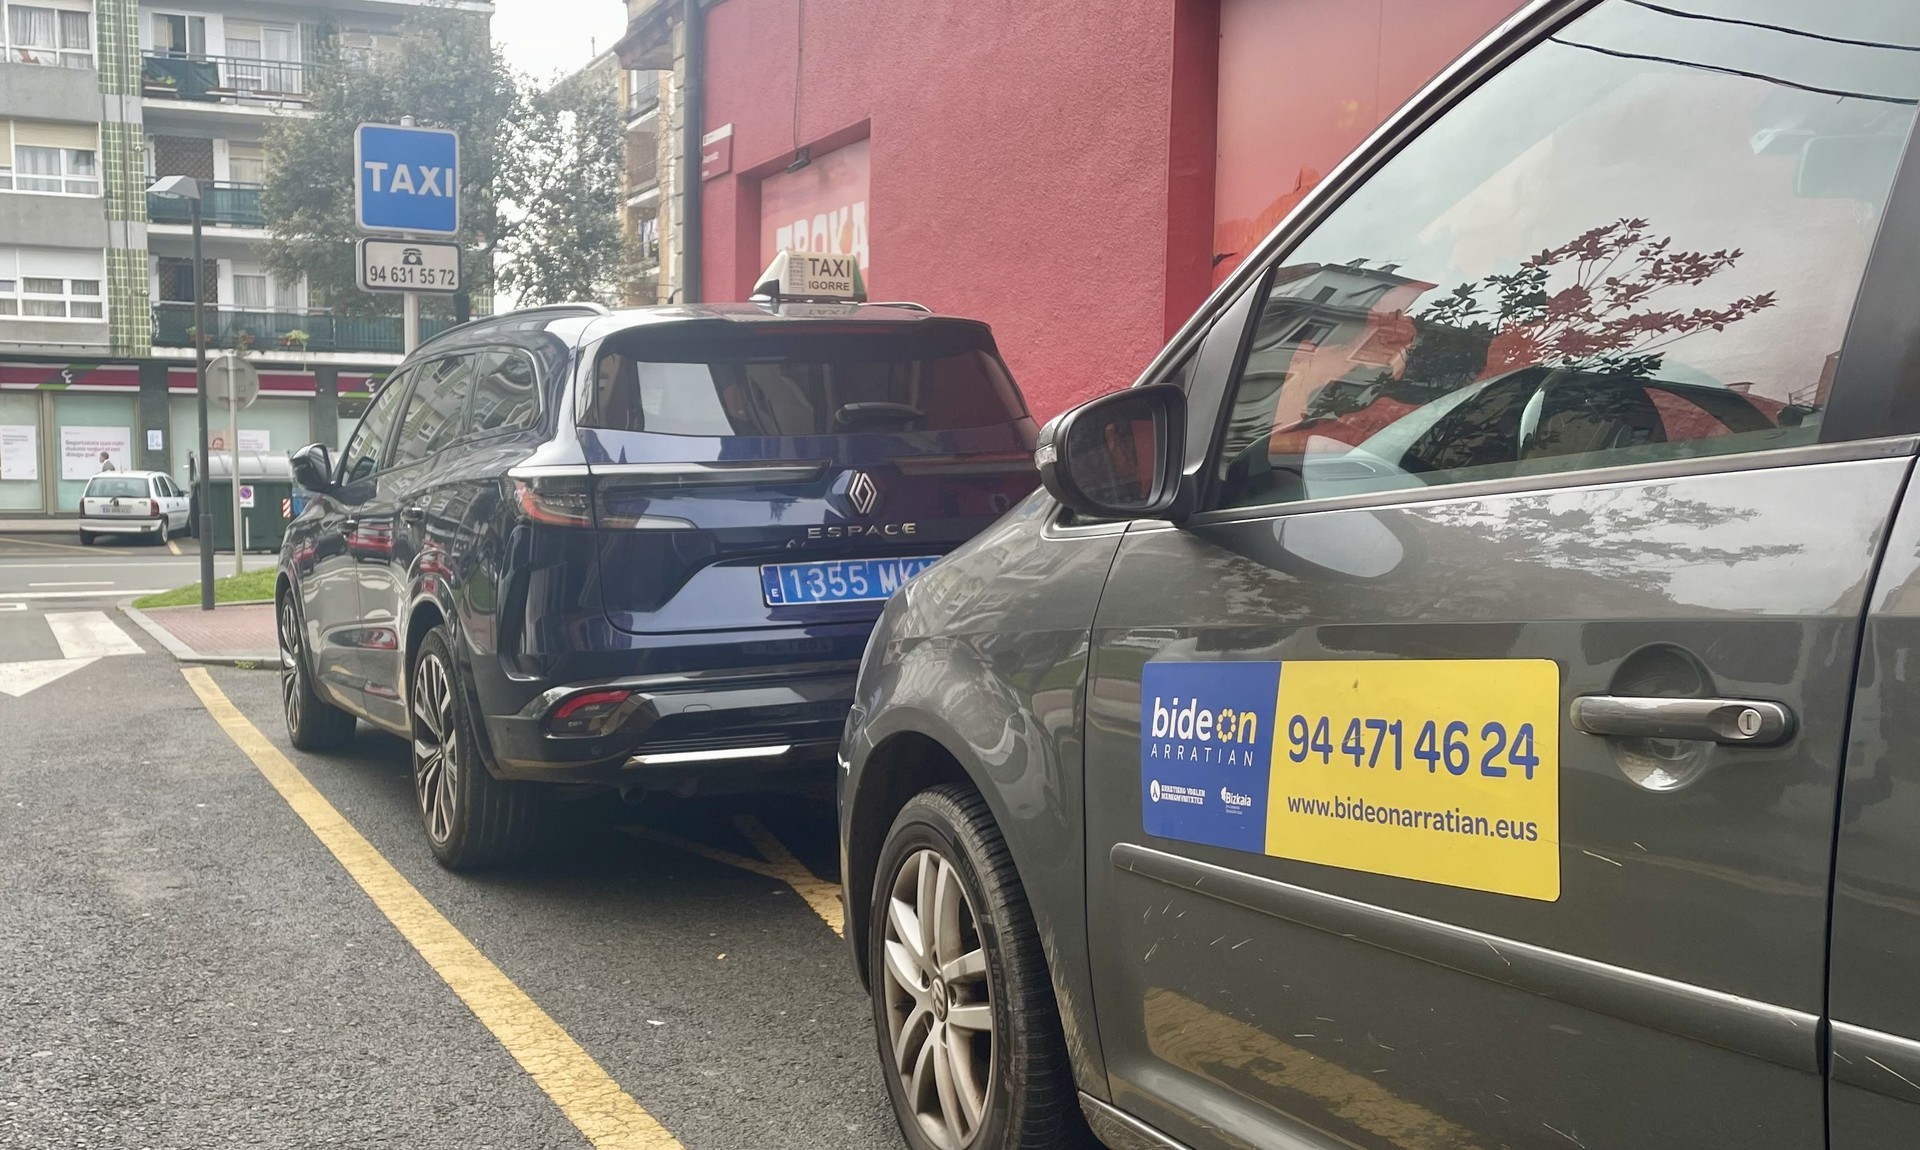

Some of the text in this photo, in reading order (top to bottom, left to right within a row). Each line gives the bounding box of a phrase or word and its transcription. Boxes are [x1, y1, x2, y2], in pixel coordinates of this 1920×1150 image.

[364, 161, 454, 198] TAXI
[370, 265, 455, 286] 94 631 55 72
[808, 257, 850, 278] TAXI
[808, 280, 850, 292] IGORRE
[807, 522, 916, 539] ESPACE
[771, 588, 779, 597] E
[789, 564, 868, 599] 1355
[1151, 697, 1257, 744] bideon
[1150, 743, 1254, 767] ARRATIAN
[1288, 714, 1540, 781] 94 471 46 24
[1225, 791, 1252, 807] Bizkaia
[1287, 795, 1539, 842] www.bideonarratian.eus
